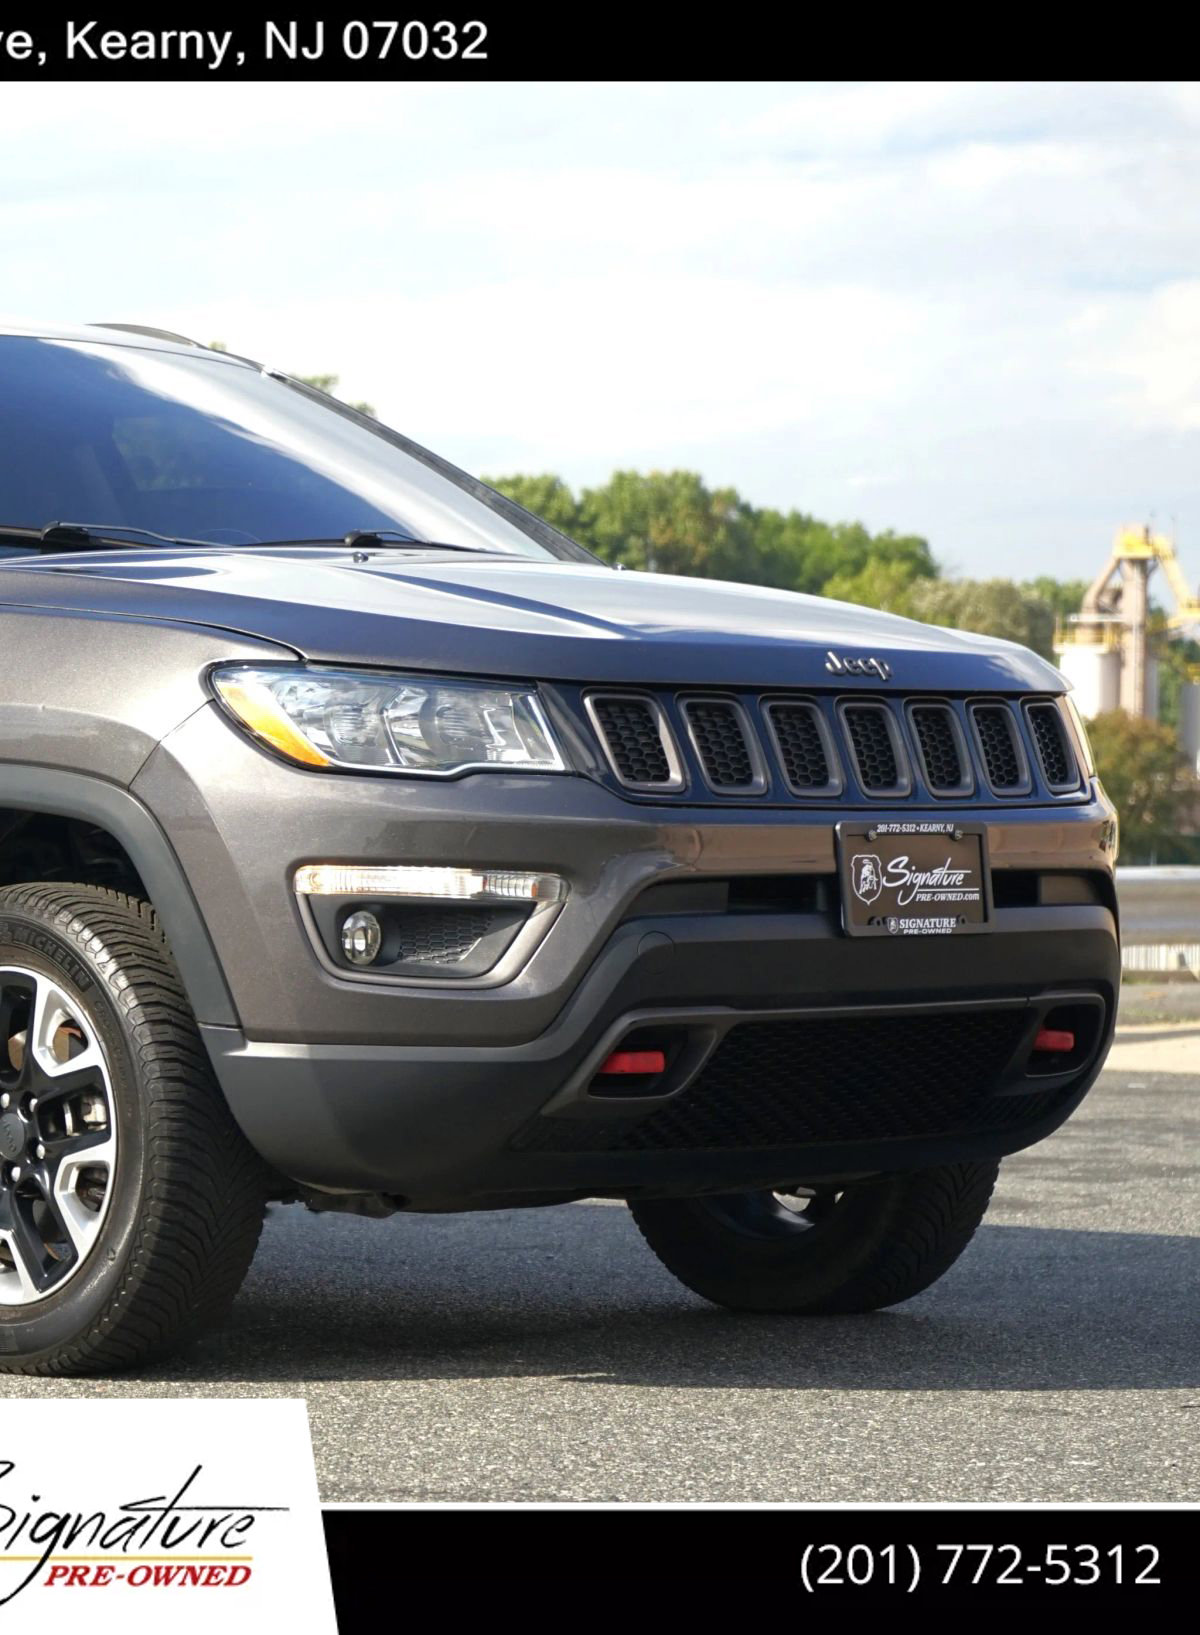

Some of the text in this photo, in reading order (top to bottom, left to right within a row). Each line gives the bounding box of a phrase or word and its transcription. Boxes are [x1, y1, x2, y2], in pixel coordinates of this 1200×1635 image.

[825, 650, 893, 681] Jeep
[882, 855, 972, 906] Signature
[915, 892, 980, 902] PRE-OWNED.com
[899, 917, 957, 929] SIGNATURE
[13, 925, 91, 989] MICHELIN
